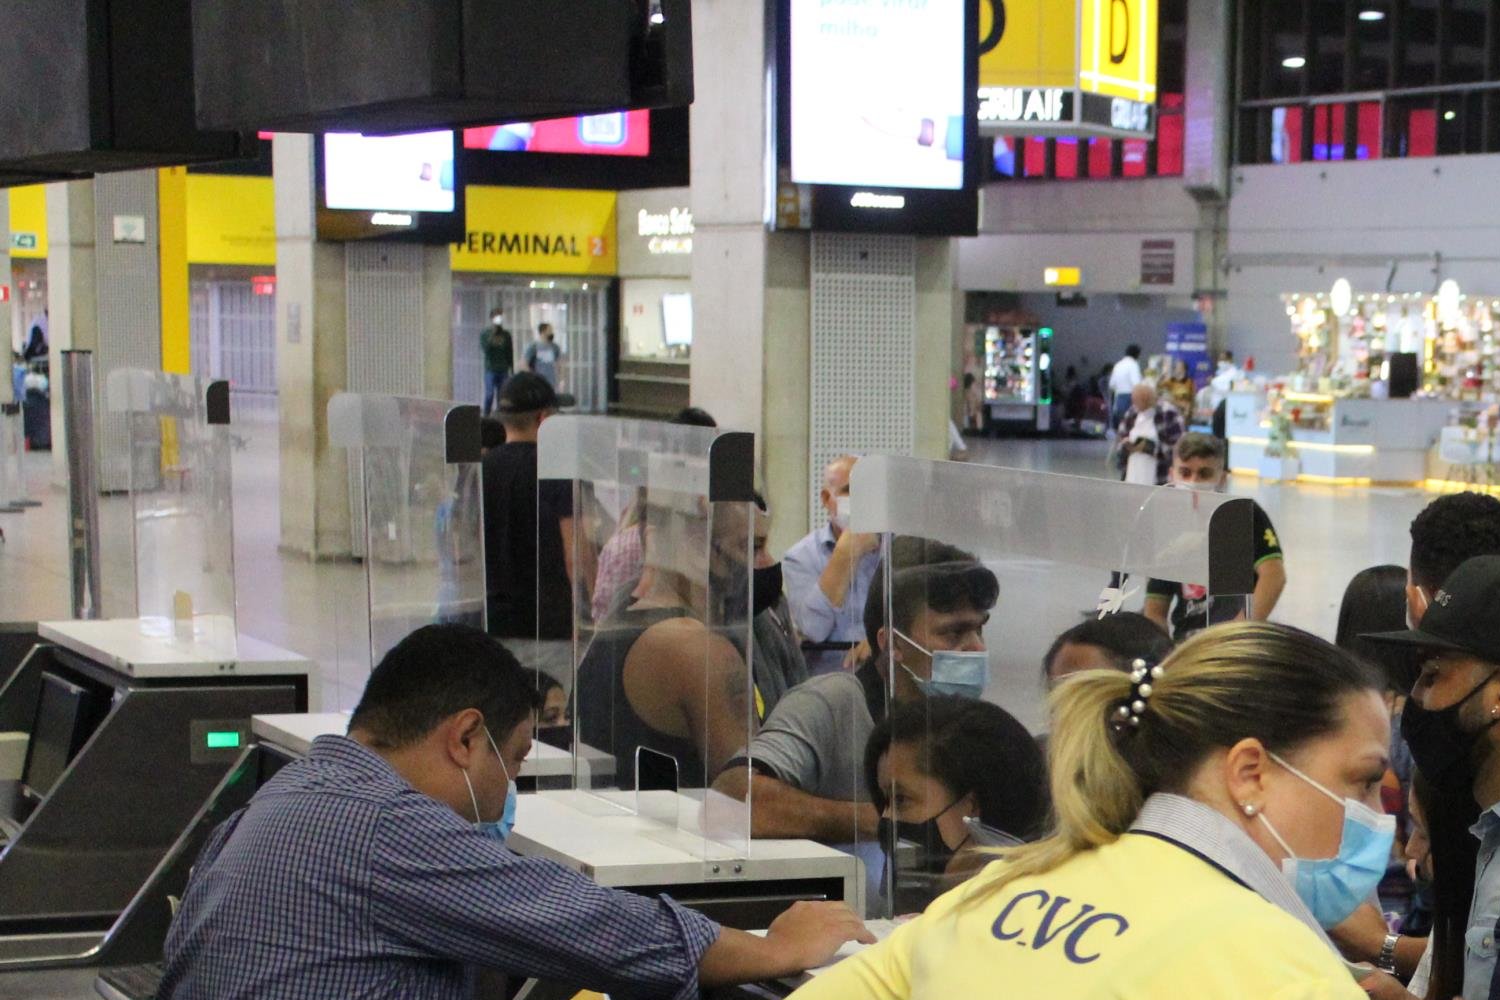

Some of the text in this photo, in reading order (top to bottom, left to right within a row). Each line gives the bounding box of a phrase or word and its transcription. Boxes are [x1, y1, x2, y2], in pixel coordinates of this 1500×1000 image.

[1110, 0, 1130, 64] D
[592, 236, 603, 256] 2
[991, 889, 1129, 964] CVC
